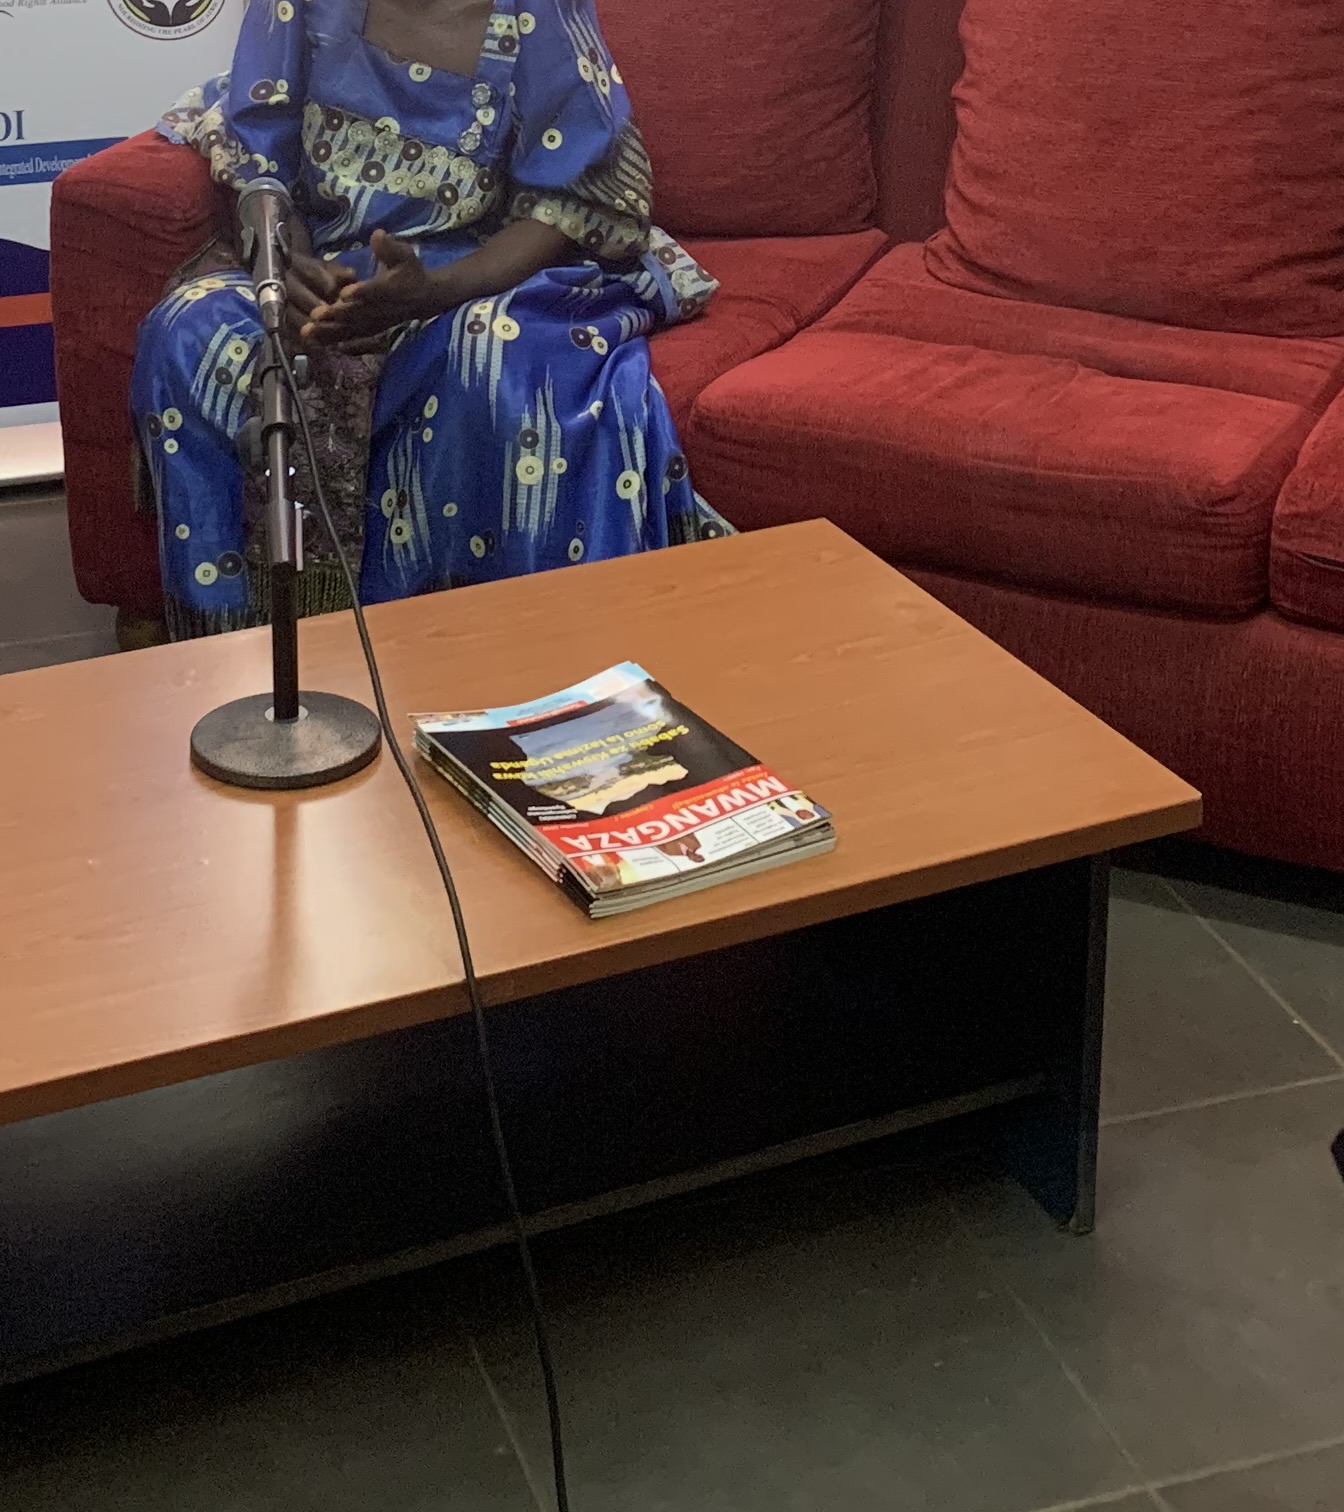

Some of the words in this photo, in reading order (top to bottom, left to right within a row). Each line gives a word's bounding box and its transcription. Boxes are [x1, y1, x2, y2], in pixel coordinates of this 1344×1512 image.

[35, 153, 92, 172] Developm
[629, 724, 689, 749] Sababu
[560, 775, 789, 851] MWANGAZA
